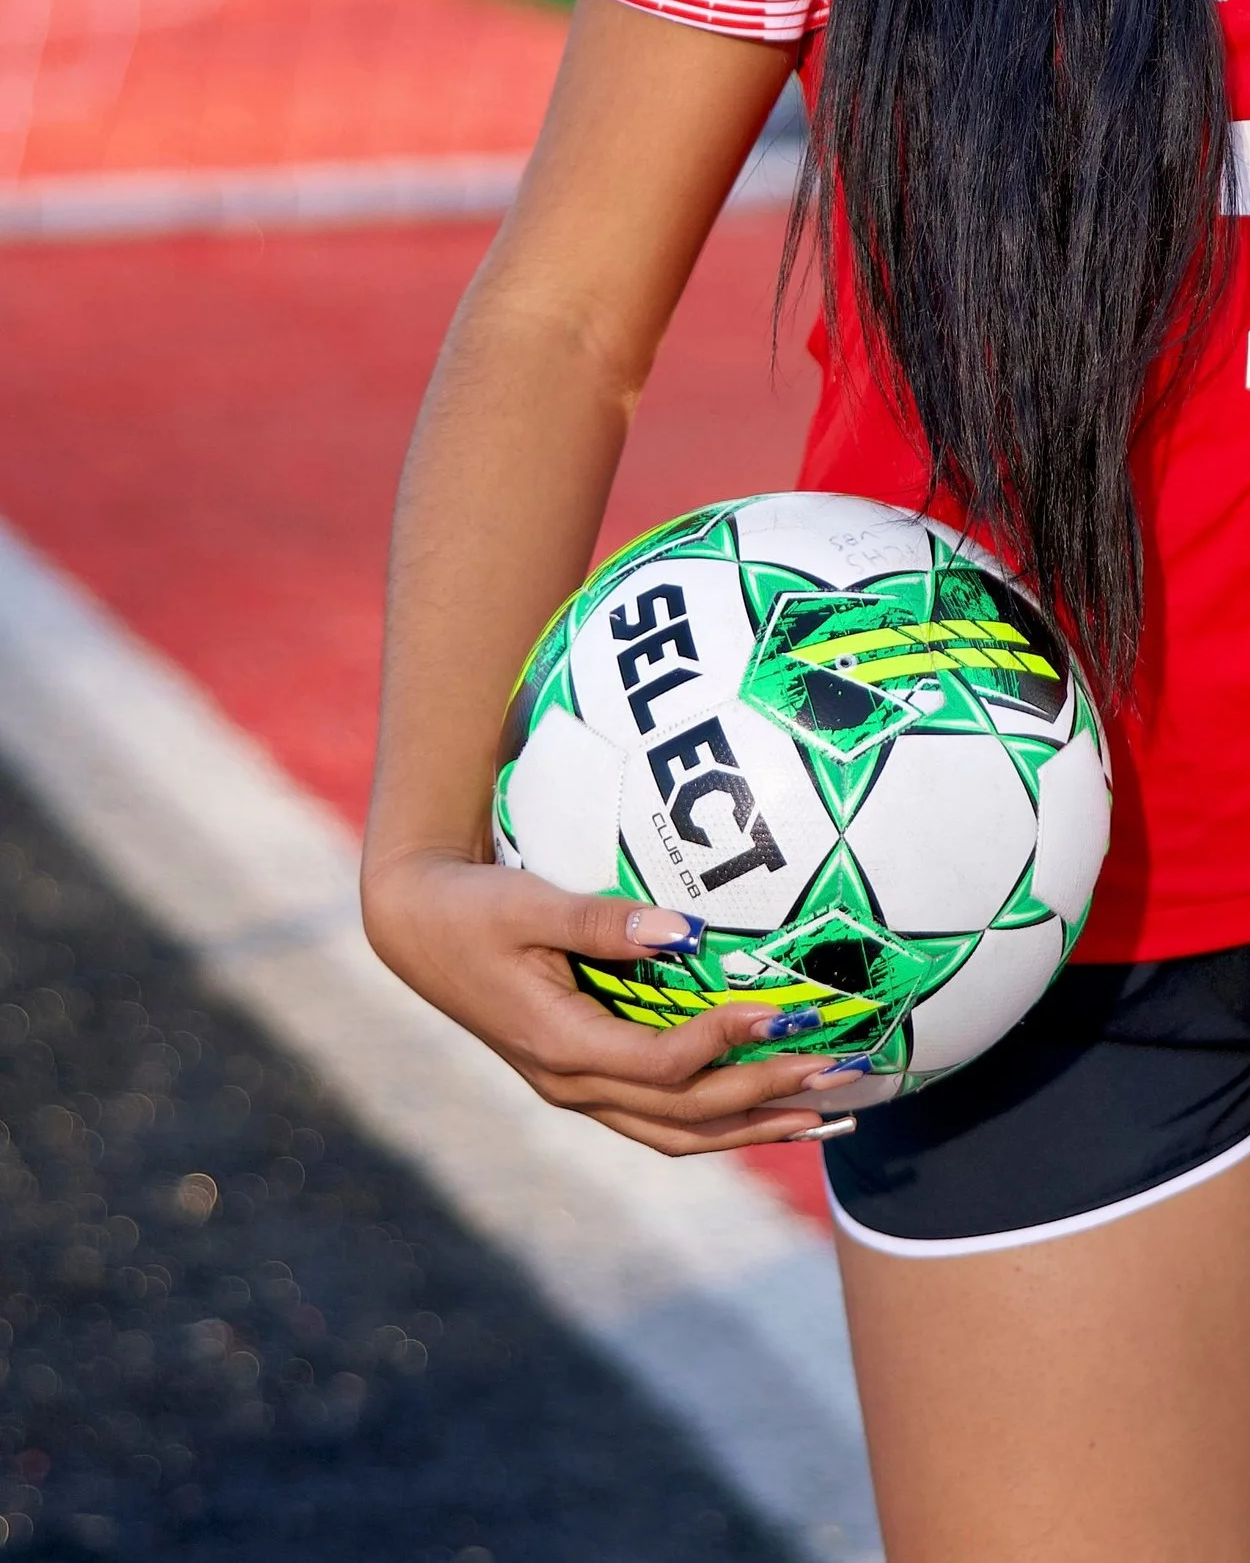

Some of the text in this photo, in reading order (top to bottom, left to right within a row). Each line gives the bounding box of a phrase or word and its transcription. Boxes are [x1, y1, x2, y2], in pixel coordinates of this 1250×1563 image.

[609, 583, 787, 892] SELECT
[652, 812, 701, 899] CLUB DB
